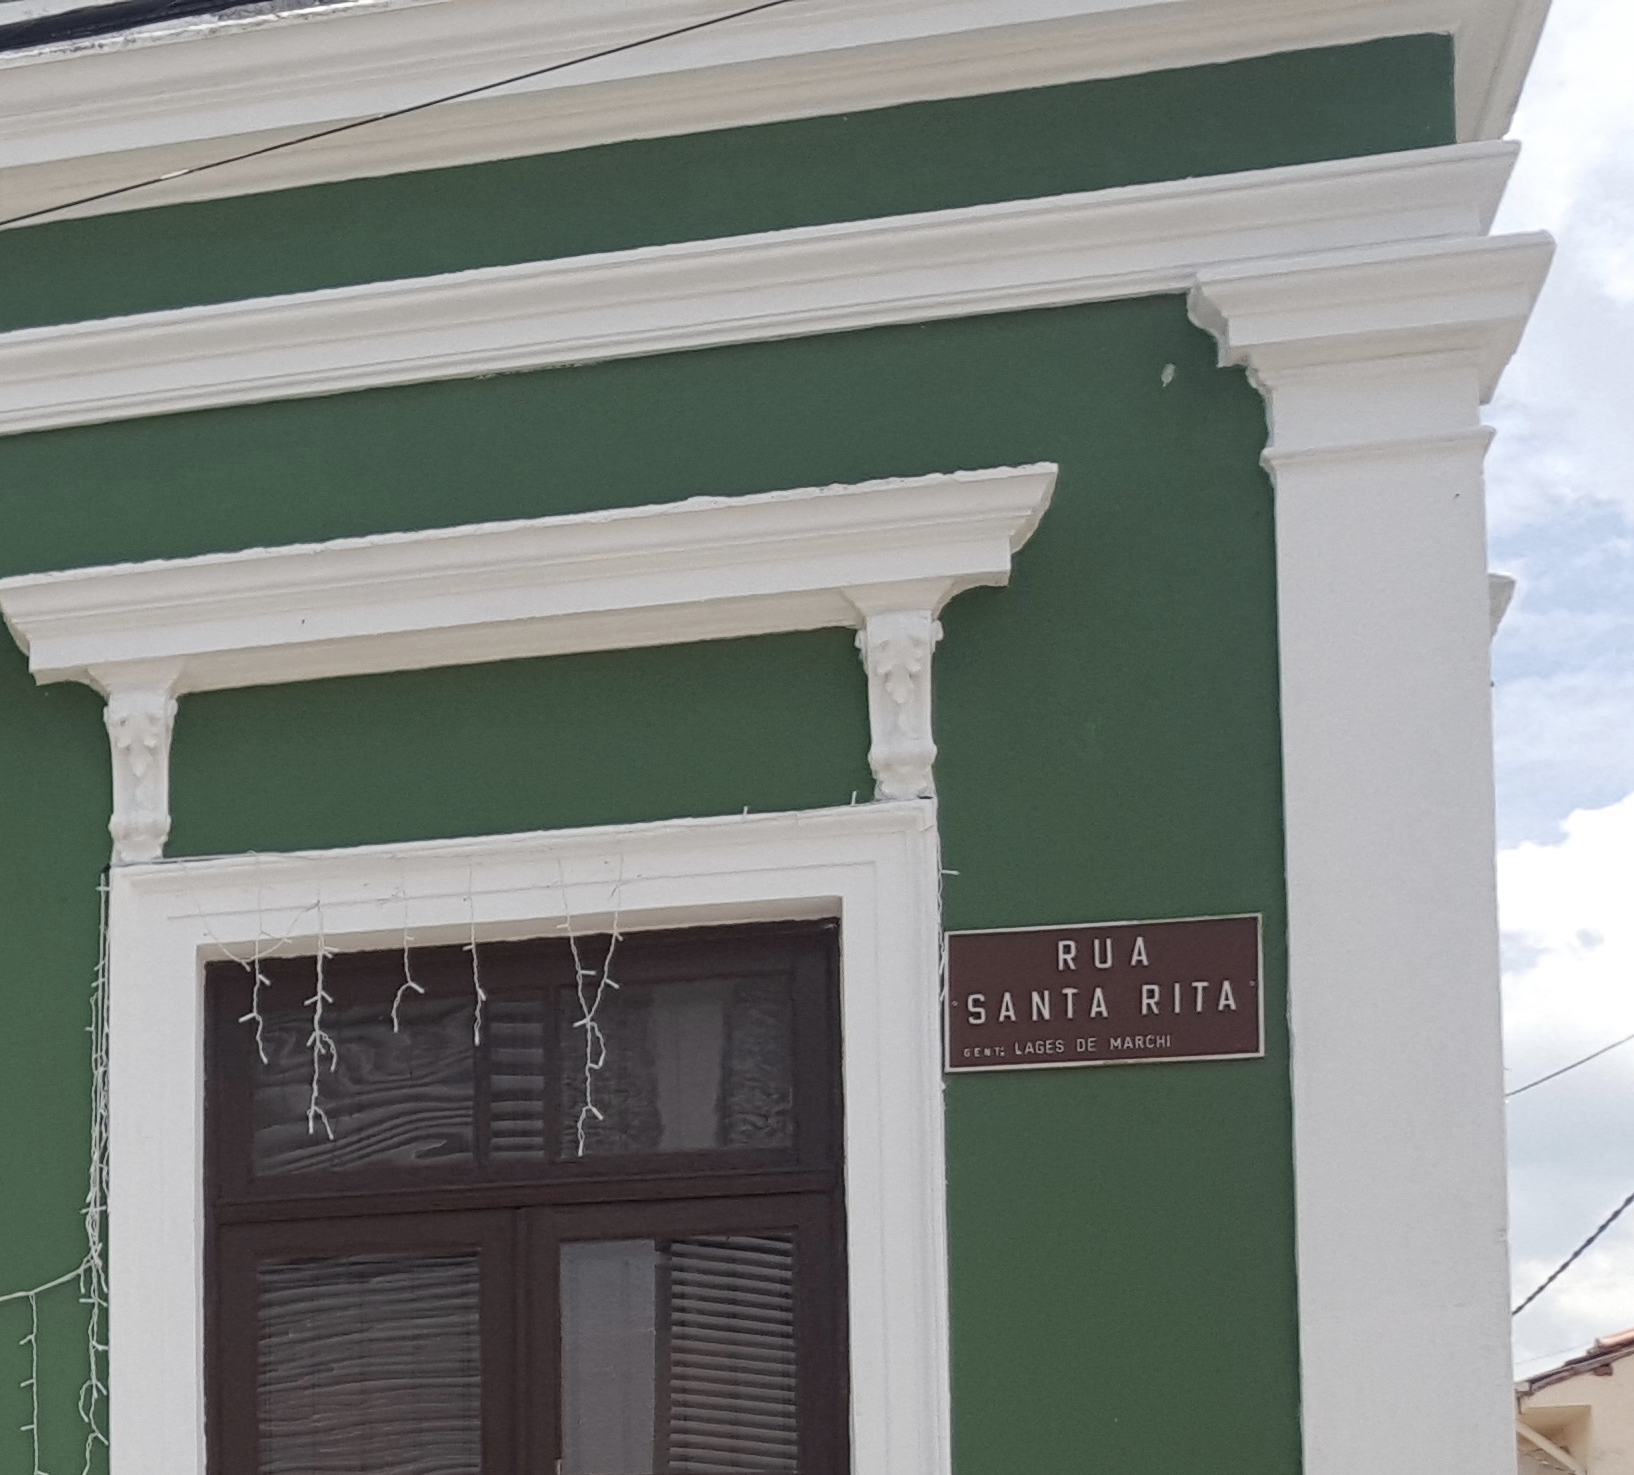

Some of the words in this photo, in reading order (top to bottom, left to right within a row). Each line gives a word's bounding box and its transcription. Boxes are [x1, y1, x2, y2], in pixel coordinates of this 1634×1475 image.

[1057, 936, 1150, 971] RUA
[966, 986, 1109, 1025] SANTA
[1141, 980, 1237, 1016] RITA
[1014, 1039, 1065, 1056] LAGES
[1076, 1037, 1097, 1052] DE
[1109, 1034, 1172, 1050] MARCHI
